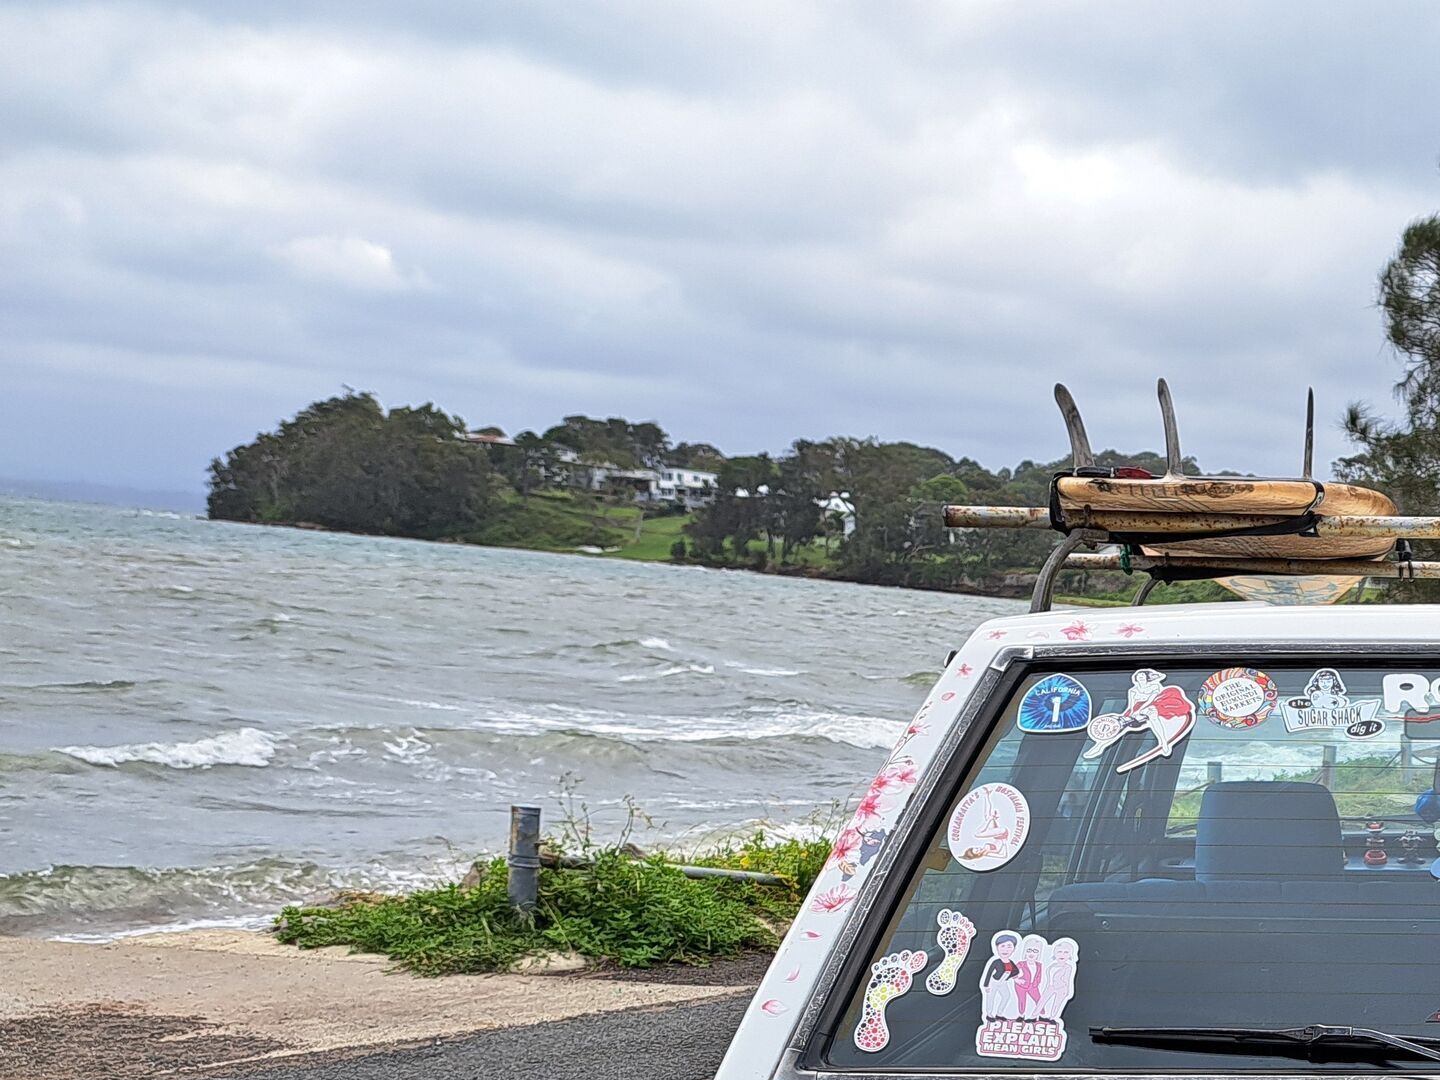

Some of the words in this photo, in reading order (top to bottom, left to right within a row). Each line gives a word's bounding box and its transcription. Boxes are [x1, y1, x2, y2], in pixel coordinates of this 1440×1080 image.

[1035, 686, 1080, 697] CALIFORNIA
[1214, 683, 1257, 702] ORIGINAL
[1222, 681, 1242, 692] THE
[1050, 695, 1061, 723] 1
[1297, 708, 1328, 727] SUGAR
[1331, 706, 1362, 727] SHACK
[1350, 724, 1367, 735] dig
[1369, 722, 1378, 732] it
[989, 1021, 1057, 1036] PLEASE
[982, 1031, 1059, 1048] EXPLAIN
[983, 1043, 1018, 1053] MEAN
[1021, 1045, 1055, 1055] GIRLS
